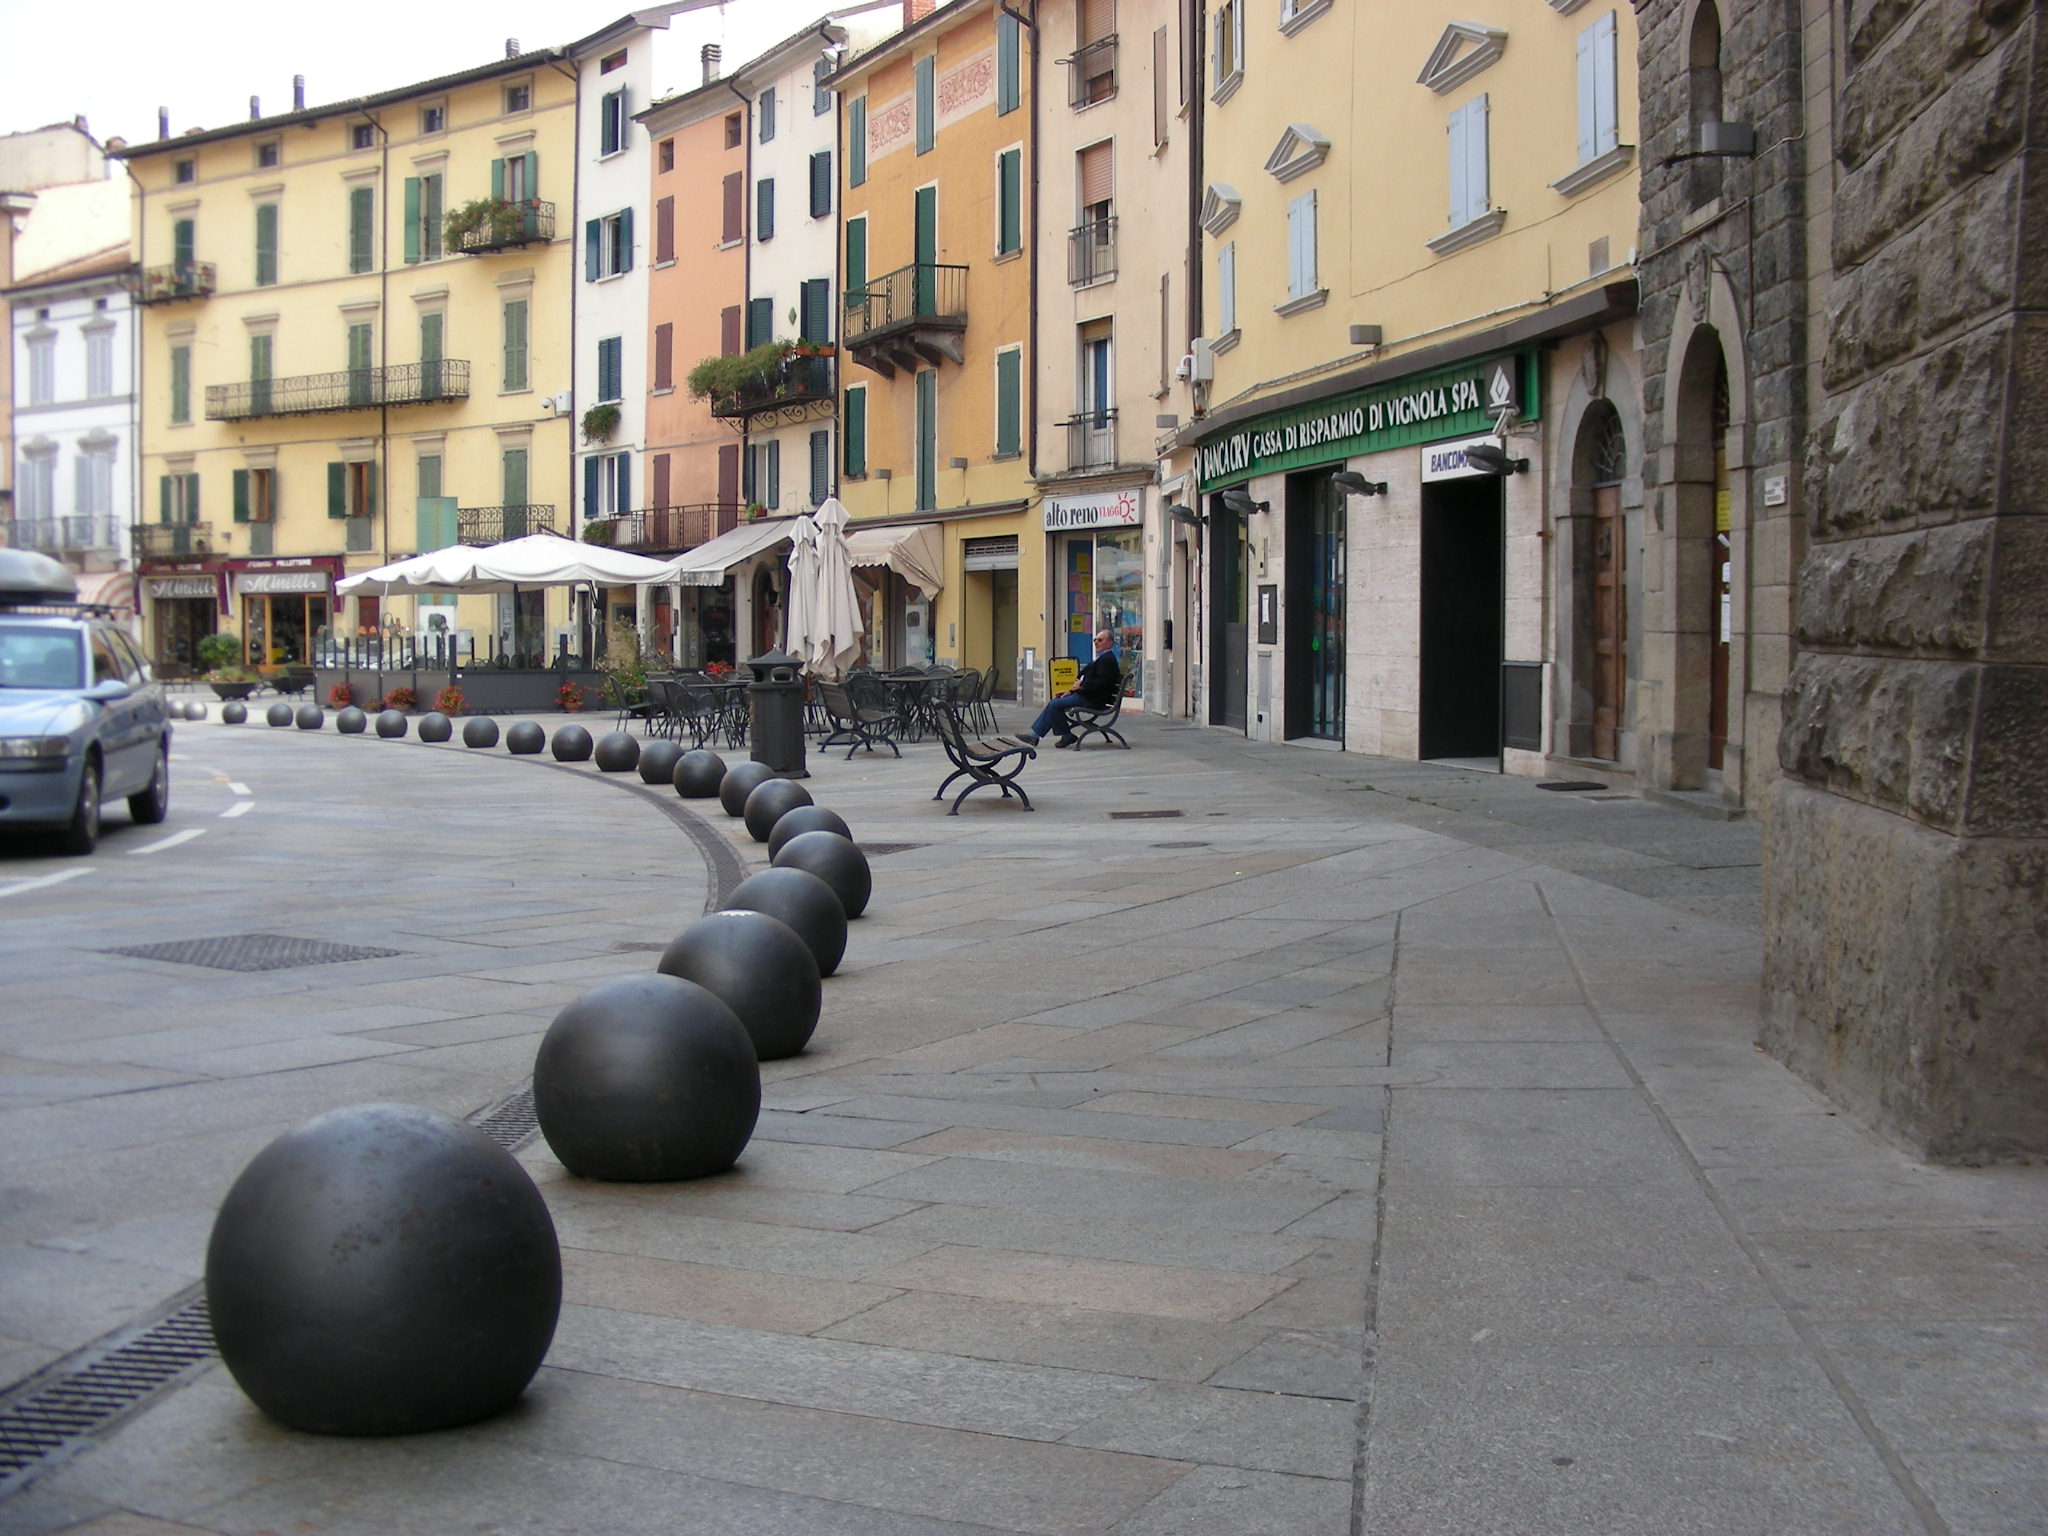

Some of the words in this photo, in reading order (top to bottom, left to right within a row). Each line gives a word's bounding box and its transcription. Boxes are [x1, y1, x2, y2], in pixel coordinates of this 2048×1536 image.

[1253, 430, 1282, 458] CASSA
[1286, 426, 1297, 450] DI
[1300, 407, 1364, 447] RISPARMIO
[1369, 403, 1383, 431] DI
[1387, 388, 1447, 426] VIGNOLA
[1452, 379, 1479, 413] SPA
[1046, 502, 1068, 526] alto
[1070, 506, 1098, 525] reno
